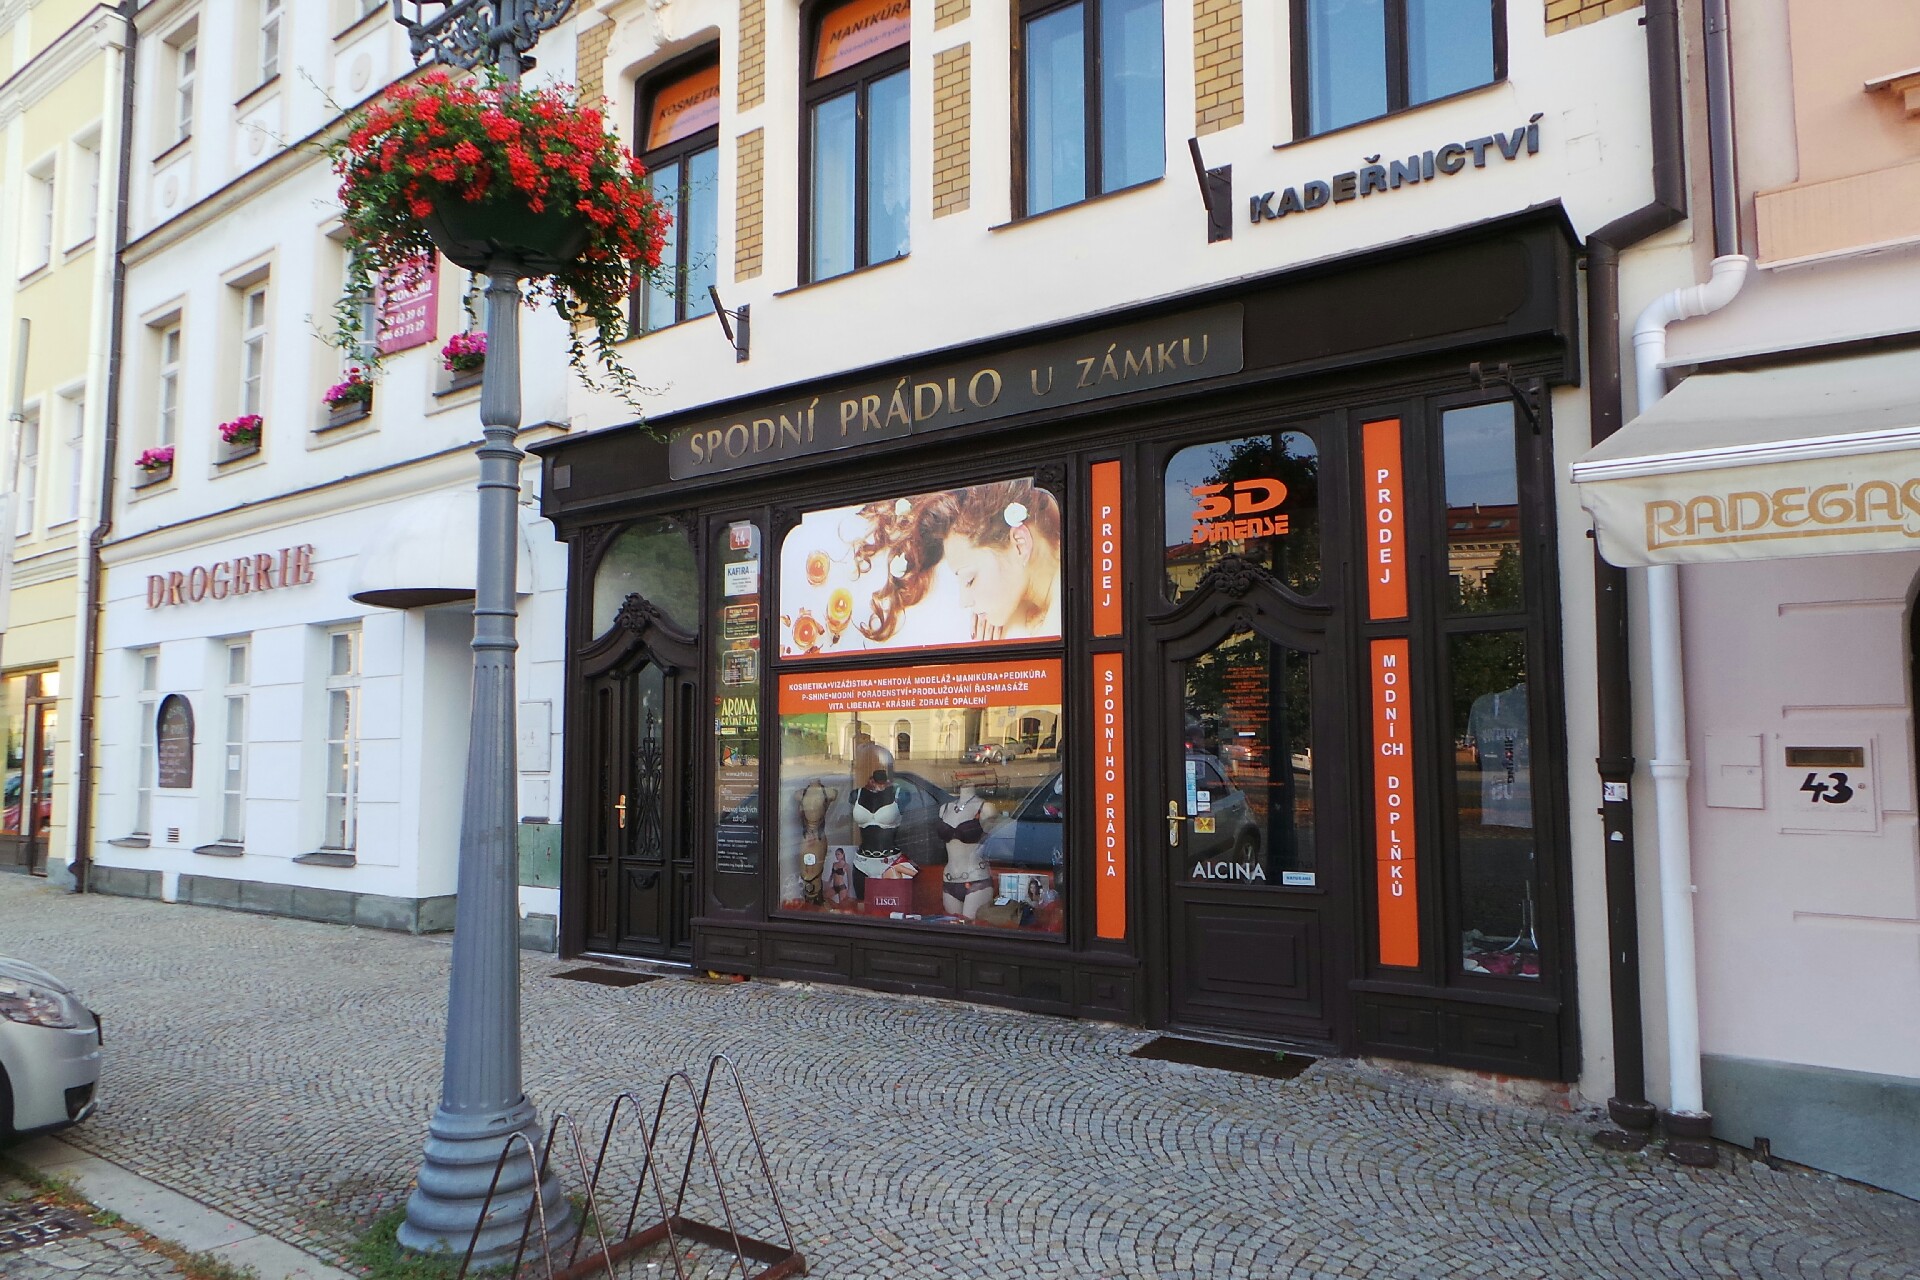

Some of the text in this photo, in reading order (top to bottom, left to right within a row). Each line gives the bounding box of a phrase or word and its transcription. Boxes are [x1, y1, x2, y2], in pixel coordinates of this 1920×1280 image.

[1250, 112, 1544, 224] KADEŘNICTVÍ
[690, 333, 1208, 466] SPODNÍ PRÁDLO U ZÁMKU
[1191, 478, 1287, 519] 3D
[1377, 468, 1393, 584] PRODEJ
[1102, 505, 1114, 607] PRODEJ
[146, 543, 318, 611] DROGERIE
[788, 681, 828, 691] KOSMETIKA
[877, 675, 912, 686] NEHTOVÁ
[914, 673, 951, 684] MODELÁŽ
[828, 702, 844, 711] VITA
[846, 700, 881, 709] LIBERATA
[886, 697, 916, 708] KRÁSNÉ
[952, 694, 987, 705] OPÁLENÍ
[831, 689, 855, 699] MODNÍ
[857, 686, 909, 698] PORADENSTVÍ
[912, 683, 972, 695] PRODLUŽOVÁNÍ
[994, 681, 1029, 692] MASÁŽE
[721, 697, 757, 716] AROMA
[1104, 670, 1116, 877] SPODNÍHO PRÁDLA
[1381, 654, 1404, 897] MODNÍCH DOPLŇKŮ
[1800, 772, 1854, 804] 43
[1192, 861, 1267, 881] ALCINA
[875, 897, 897, 906] LISCA
